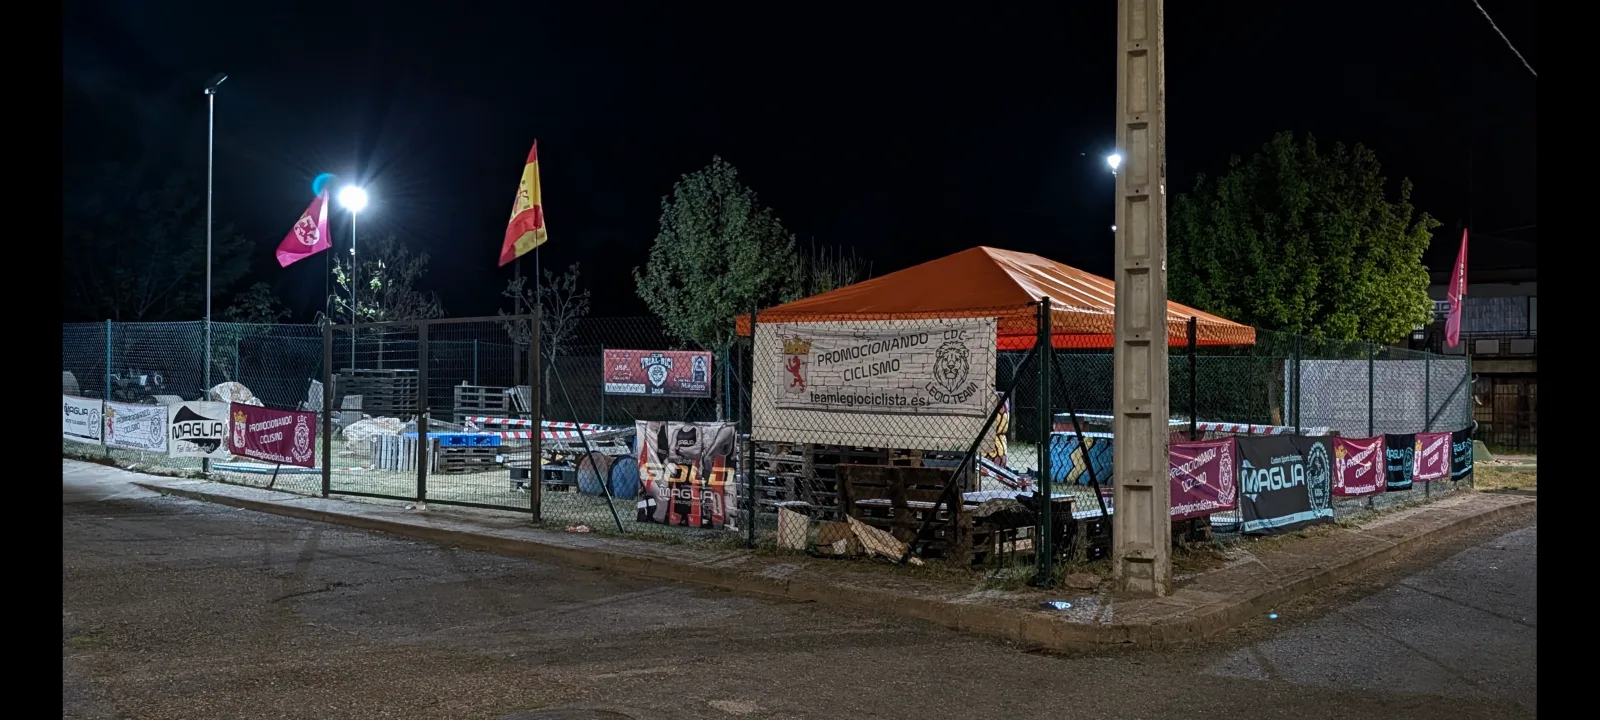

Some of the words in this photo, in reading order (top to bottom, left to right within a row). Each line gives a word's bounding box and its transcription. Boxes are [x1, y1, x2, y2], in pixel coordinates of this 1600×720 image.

[943, 329, 968, 341] CDC
[817, 332, 929, 367] PROMOCIONANDO
[843, 358, 900, 382] CICLISMO
[810, 390, 924, 407] teamlegiociclista.es
[924, 381, 951, 405] LEGIO
[951, 380, 979, 405] TEAM
[64, 404, 88, 416] MAGLIA
[172, 422, 223, 439] MAGLIA
[249, 415, 293, 433] PROMOCIONANDO
[260, 432, 283, 445] CICLISMO
[1241, 463, 1305, 493] MAGLIA
[660, 486, 714, 500] MAGLIA
